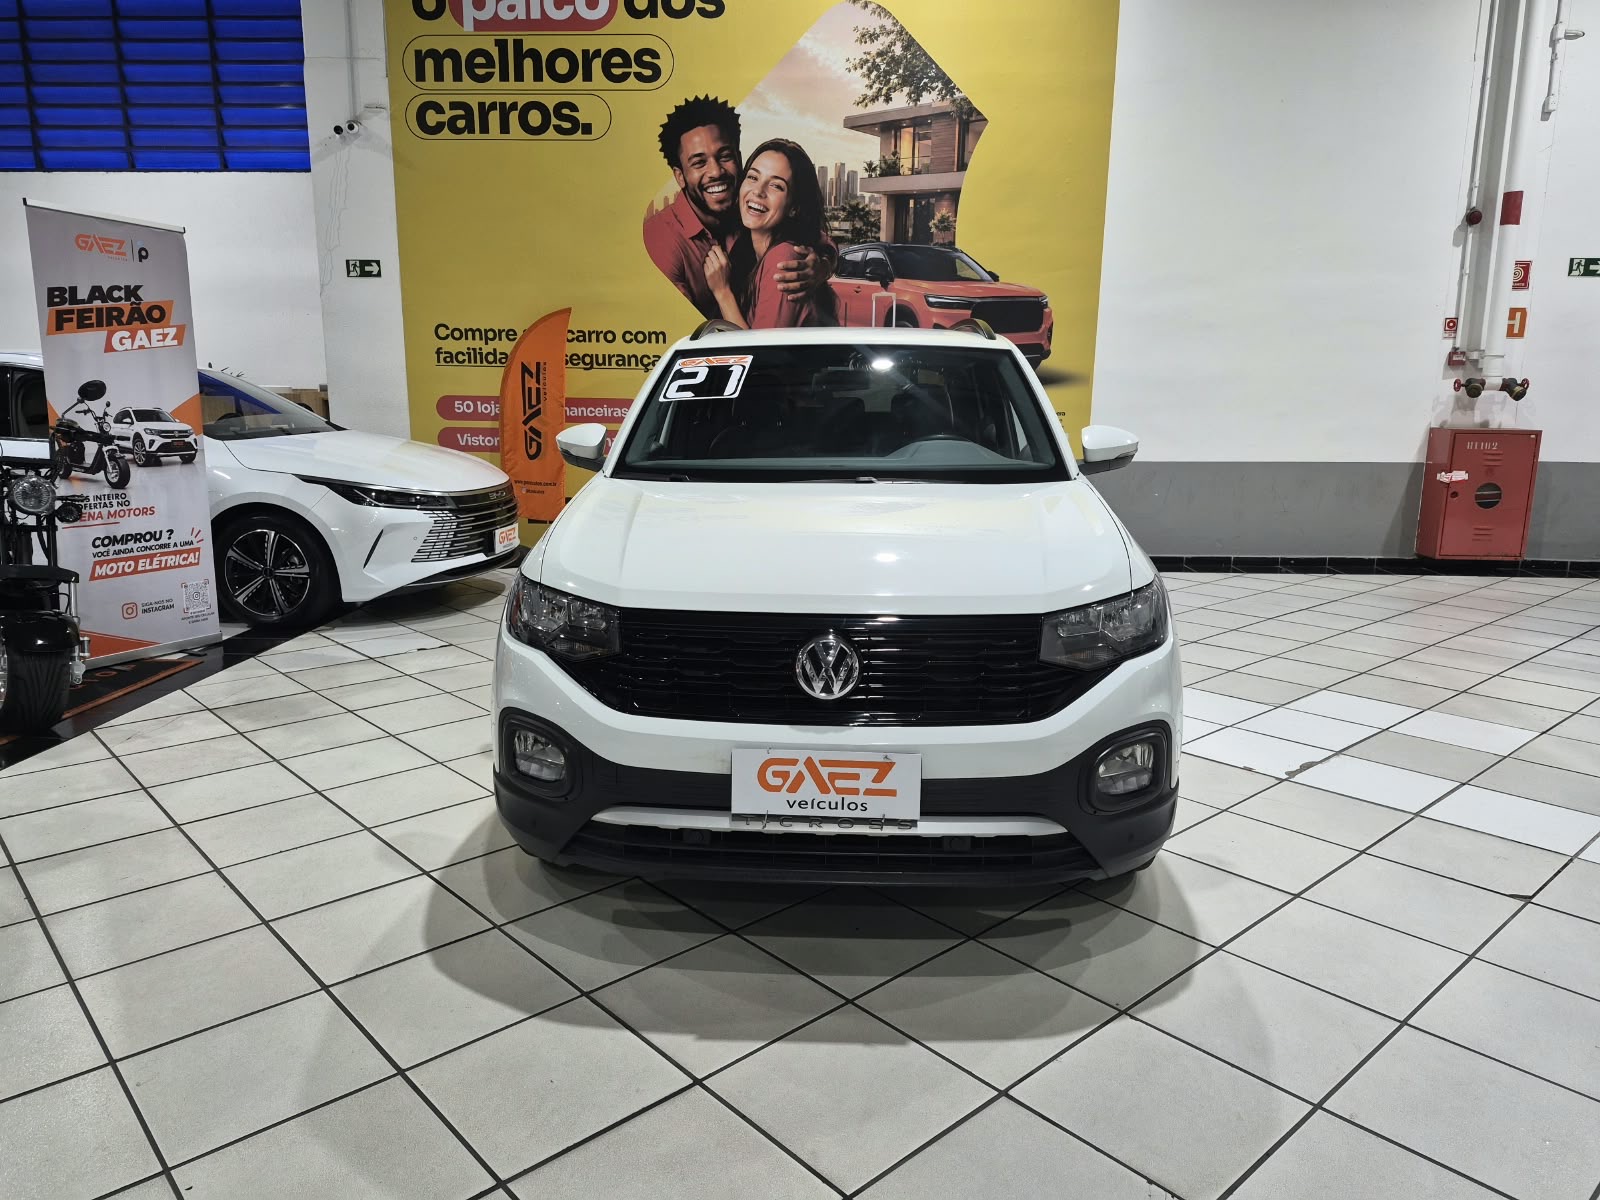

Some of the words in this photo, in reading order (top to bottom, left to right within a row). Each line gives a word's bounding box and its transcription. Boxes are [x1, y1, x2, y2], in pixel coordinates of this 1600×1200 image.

[413, 38, 662, 84] melhores
[415, 100, 593, 136] carros.
[74, 233, 127, 257] GAEZ
[47, 285, 144, 307] BLACK
[55, 301, 166, 331] FEIRÃO
[111, 327, 178, 351] GAEZ
[434, 323, 518, 345] Compre
[566, 329, 617, 343] carro
[621, 330, 666, 344] com
[435, 347, 509, 365] facilida
[665, 365, 744, 398] 21
[454, 401, 474, 413] 50
[477, 401, 500, 416] loja
[521, 361, 542, 461] GAEZ
[457, 433, 500, 446] Vistor
[92, 492, 127, 502] INTEIRO
[116, 499, 131, 508] NO
[79, 510, 104, 522] ENA
[107, 505, 156, 520] MOTORS
[91, 529, 163, 549] COMPROU
[166, 528, 175, 540] ?
[92, 548, 110, 559] VOCÊ
[112, 547, 135, 556] AINDA
[136, 543, 172, 553] CONCORRE
[180, 540, 195, 548] UMA
[94, 561, 135, 578] MOTO
[137, 551, 200, 572] ELÉTRICA!
[141, 604, 175, 614] INSTAGRAM
[757, 756, 898, 797] GAEZ
[786, 797, 868, 812] veículos
